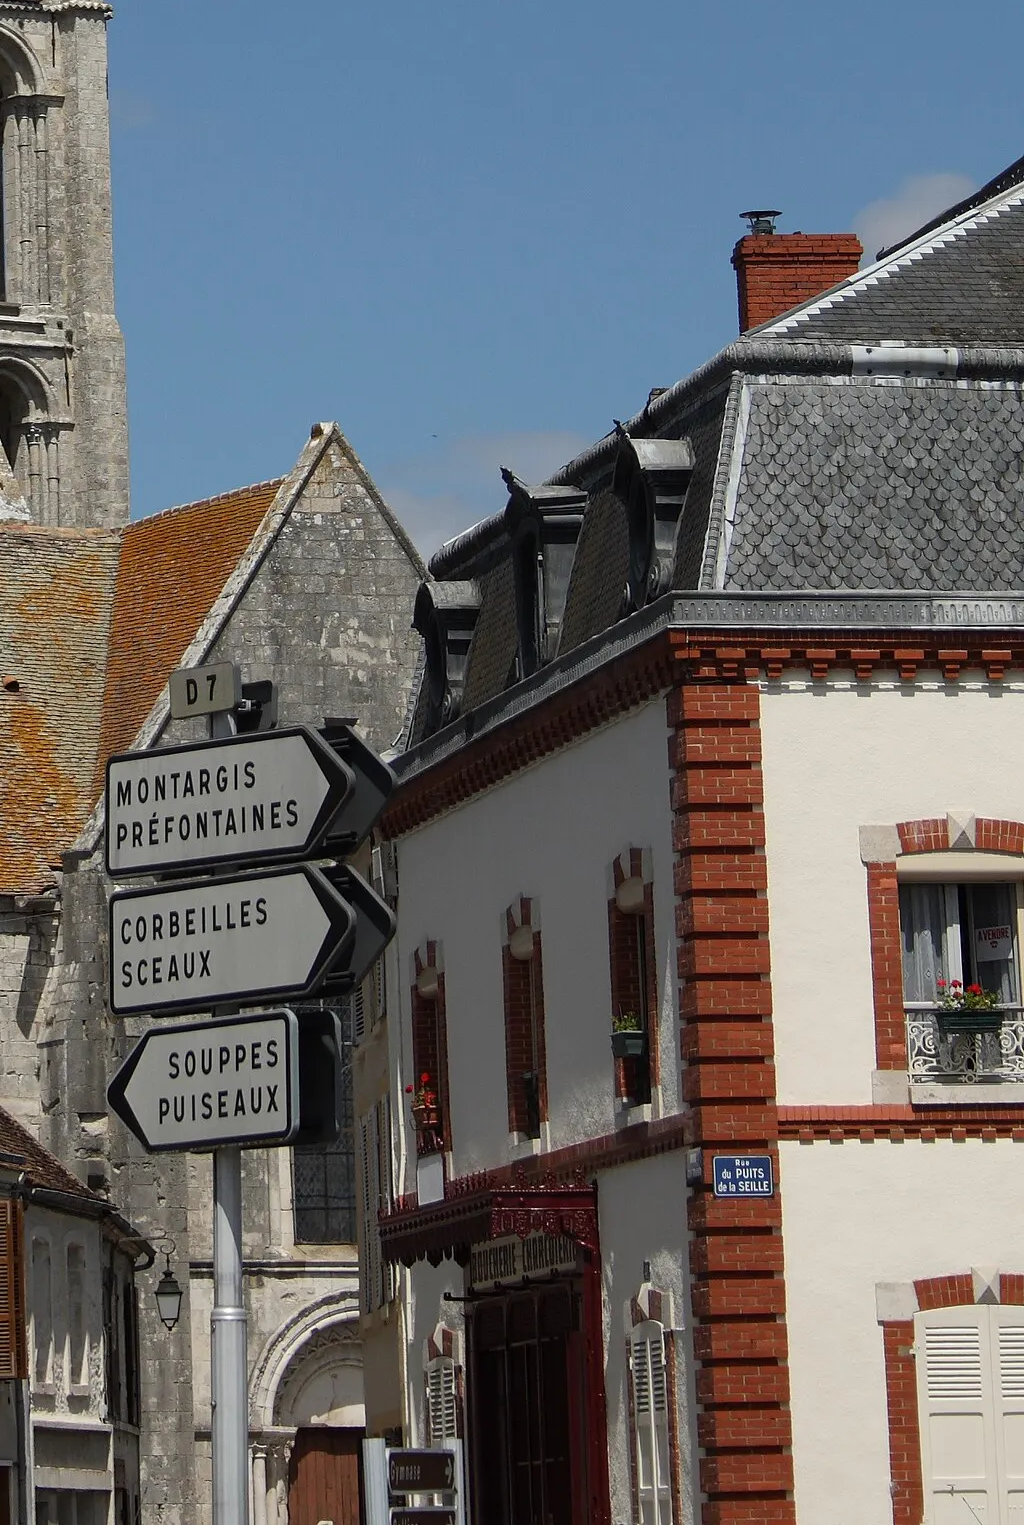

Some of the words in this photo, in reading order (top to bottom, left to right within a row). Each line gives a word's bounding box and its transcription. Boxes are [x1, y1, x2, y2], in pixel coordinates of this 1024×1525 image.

[186, 678, 198, 706] D
[206, 673, 217, 702] 7
[116, 761, 256, 808] MONTARGIS
[116, 798, 299, 850] PRÉFONTAINES
[120, 897, 268, 945] CORBEILLES
[121, 950, 212, 988] SCEAUX
[168, 1039, 279, 1080] SOUPPES
[158, 1084, 279, 1126] PUISEAUX
[718, 1181, 727, 1192] de
[729, 1181, 736, 1192] la
[738, 1181, 769, 1192] SEILLE
[721, 1169, 732, 1180] du
[736, 1168, 765, 1179] PUITS
[471, 1241, 517, 1284] BOUCHERIE
[390, 1459, 421, 1486] Gymnase
